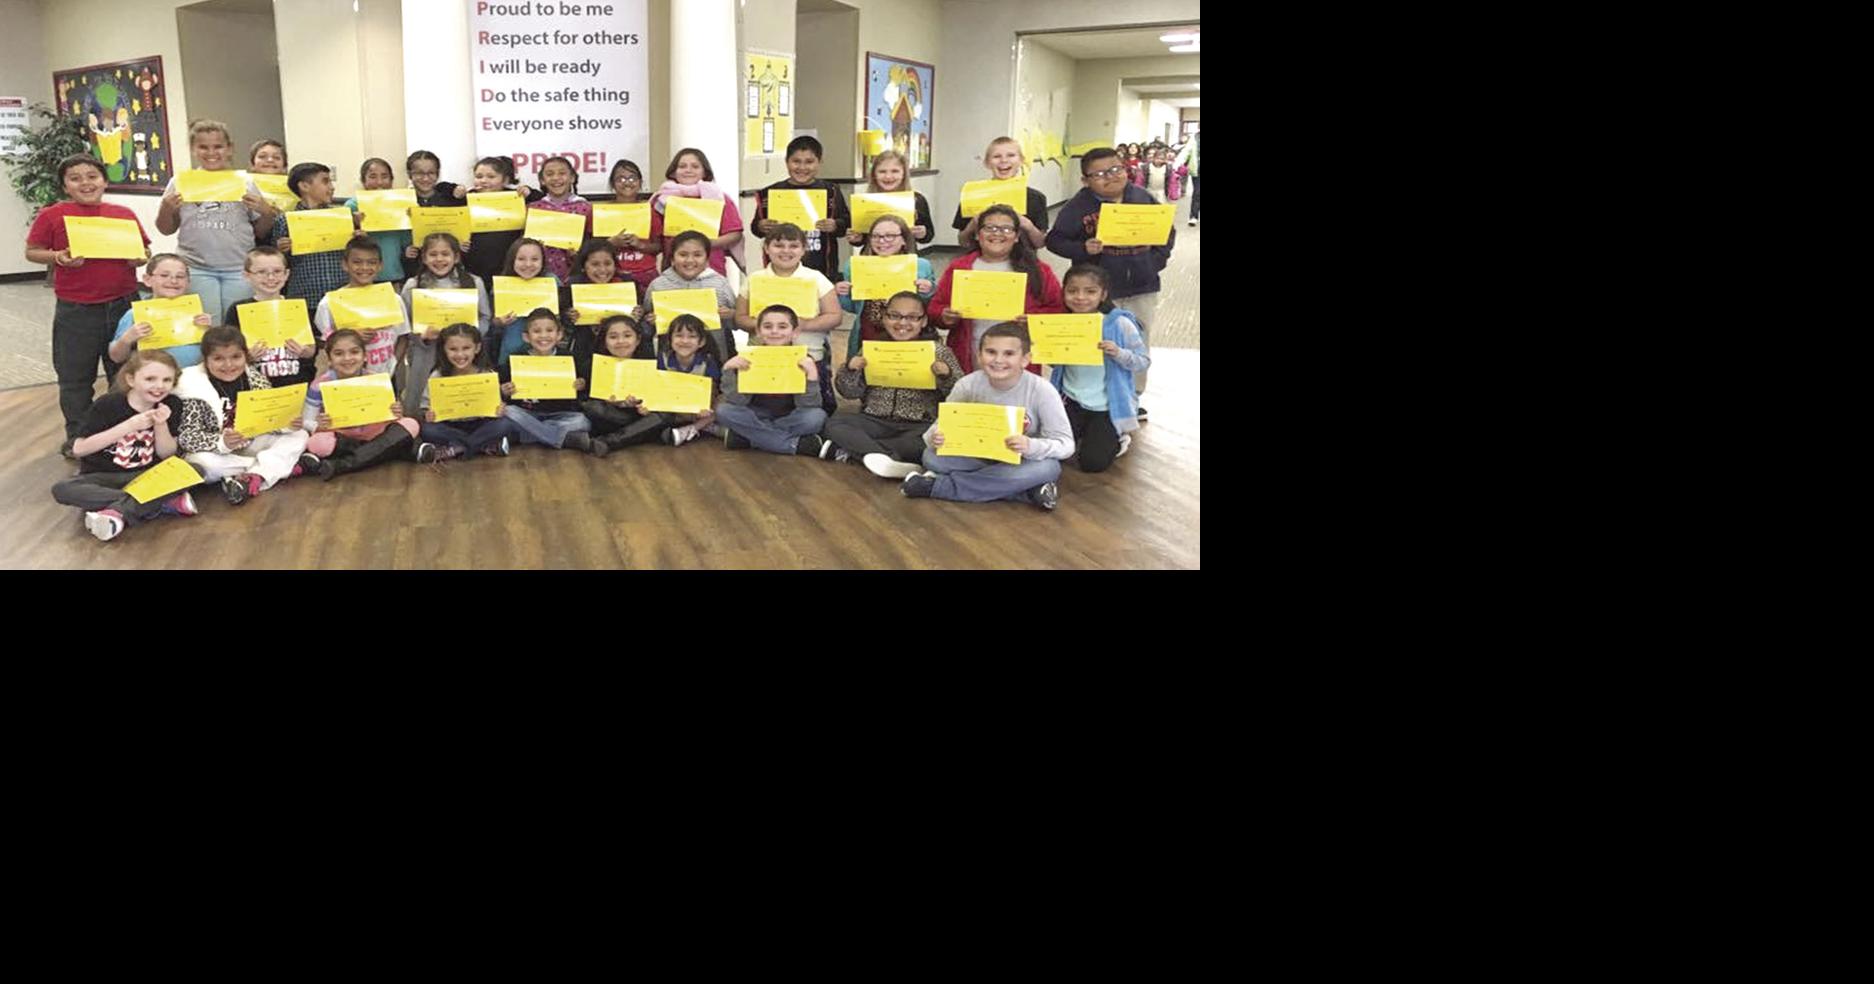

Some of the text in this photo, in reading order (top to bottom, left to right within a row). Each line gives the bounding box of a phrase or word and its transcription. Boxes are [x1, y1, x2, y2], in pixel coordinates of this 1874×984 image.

[477, 1, 614, 16] Proud to be me
[479, 30, 639, 48] Respect for others
[479, 59, 601, 77] I will be ready
[481, 87, 630, 105] Do the safe thing
[482, 115, 622, 134] Everyone shows
[511, 152, 607, 175] PRDE!
